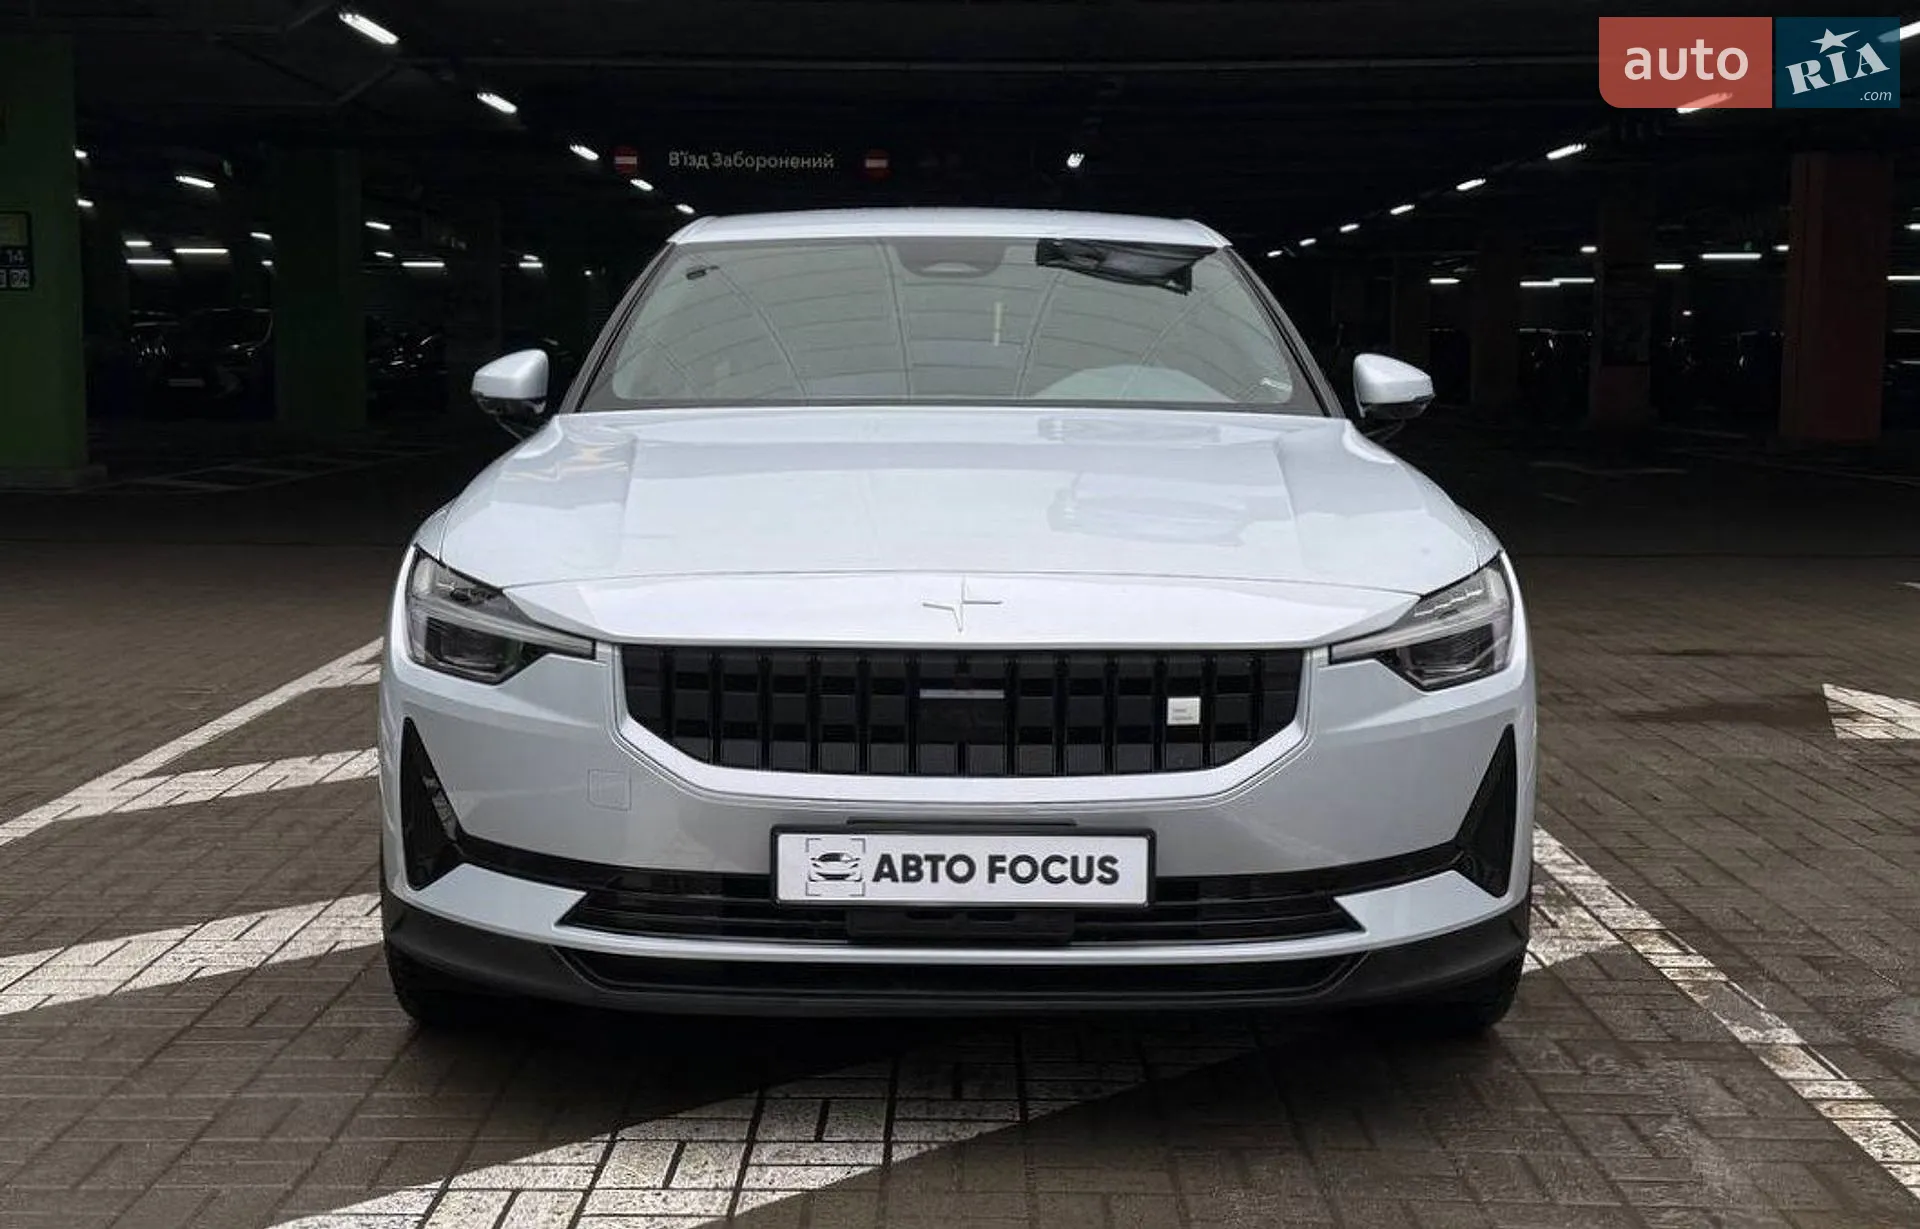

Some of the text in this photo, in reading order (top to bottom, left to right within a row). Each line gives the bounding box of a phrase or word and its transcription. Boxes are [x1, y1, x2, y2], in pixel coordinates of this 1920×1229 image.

[711, 151, 834, 172] Заборонений
[872, 854, 1119, 885] АВТО FOCUS
